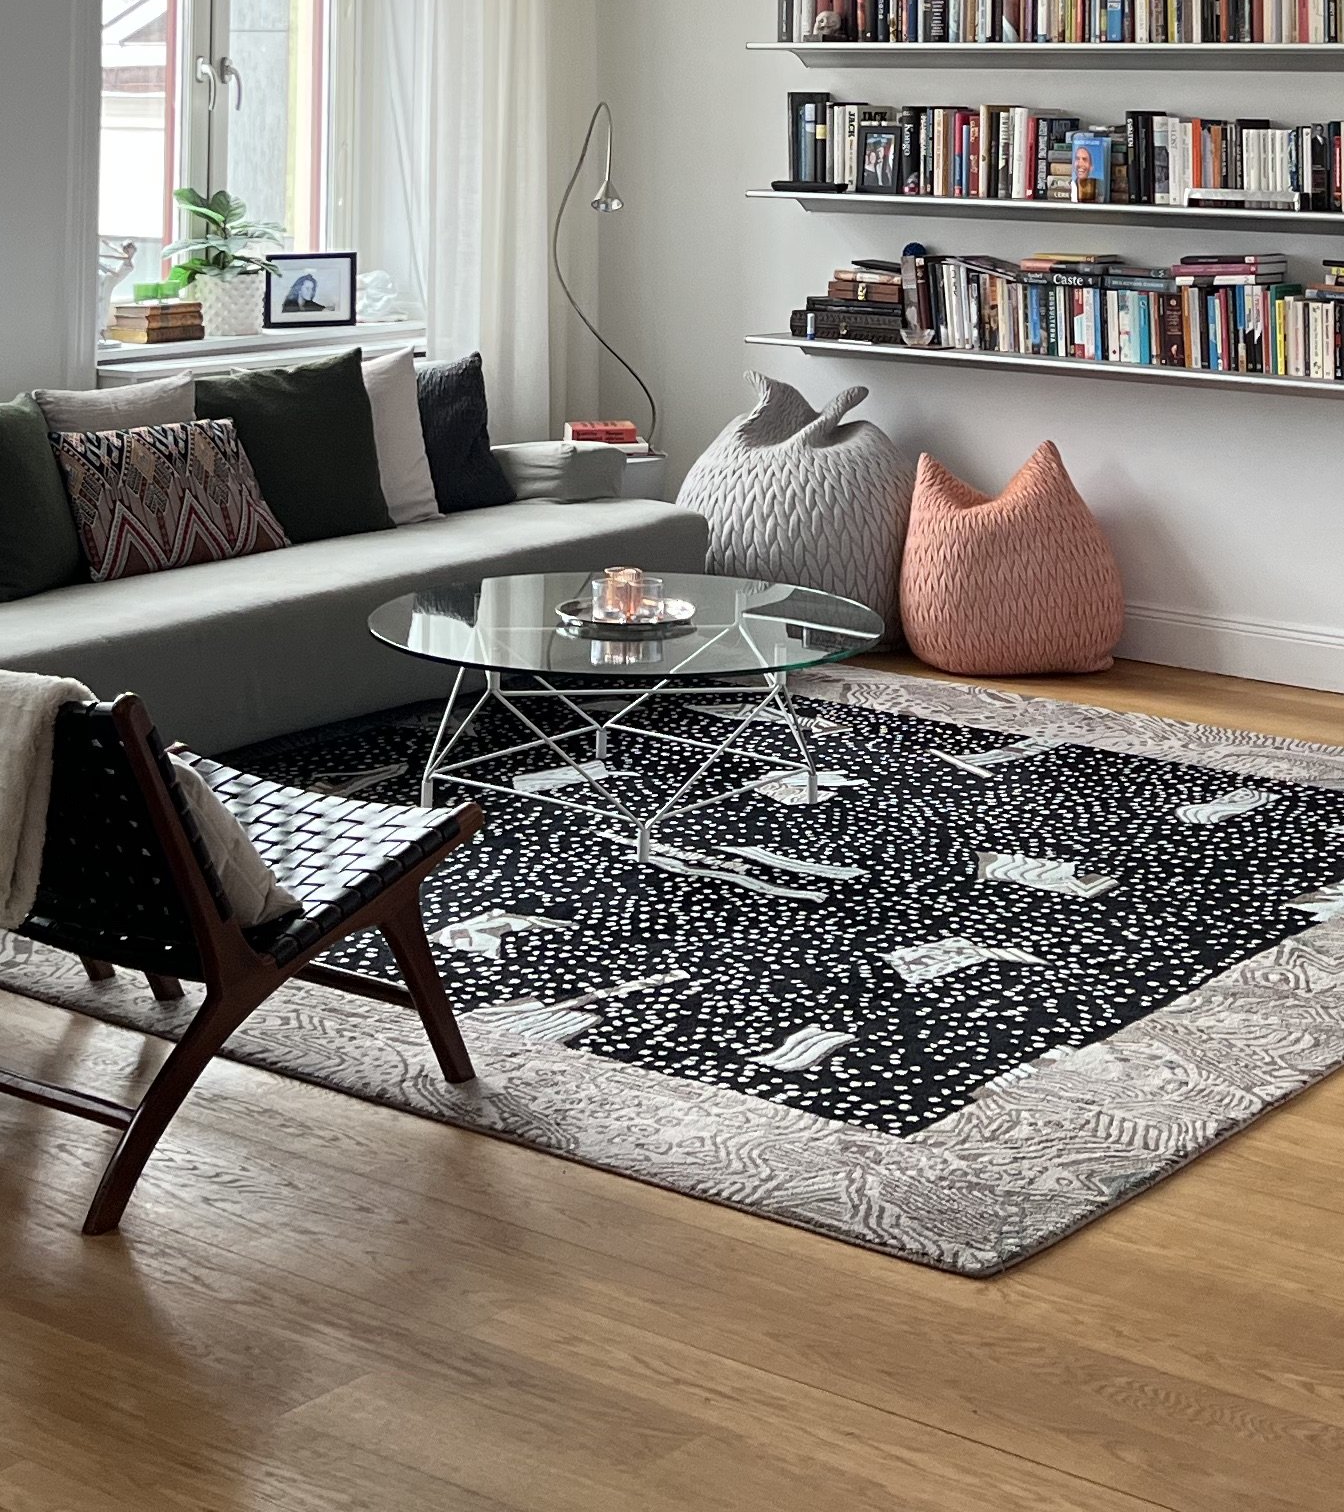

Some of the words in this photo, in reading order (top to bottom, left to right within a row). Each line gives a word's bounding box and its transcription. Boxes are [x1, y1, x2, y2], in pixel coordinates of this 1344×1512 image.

[848, 111, 856, 137] JACK
[862, 111, 887, 121] JACK
[902, 123, 913, 156] Kongo
[1053, 273, 1084, 286] Caste
[1048, 291, 1056, 343] KONSULTERNA
